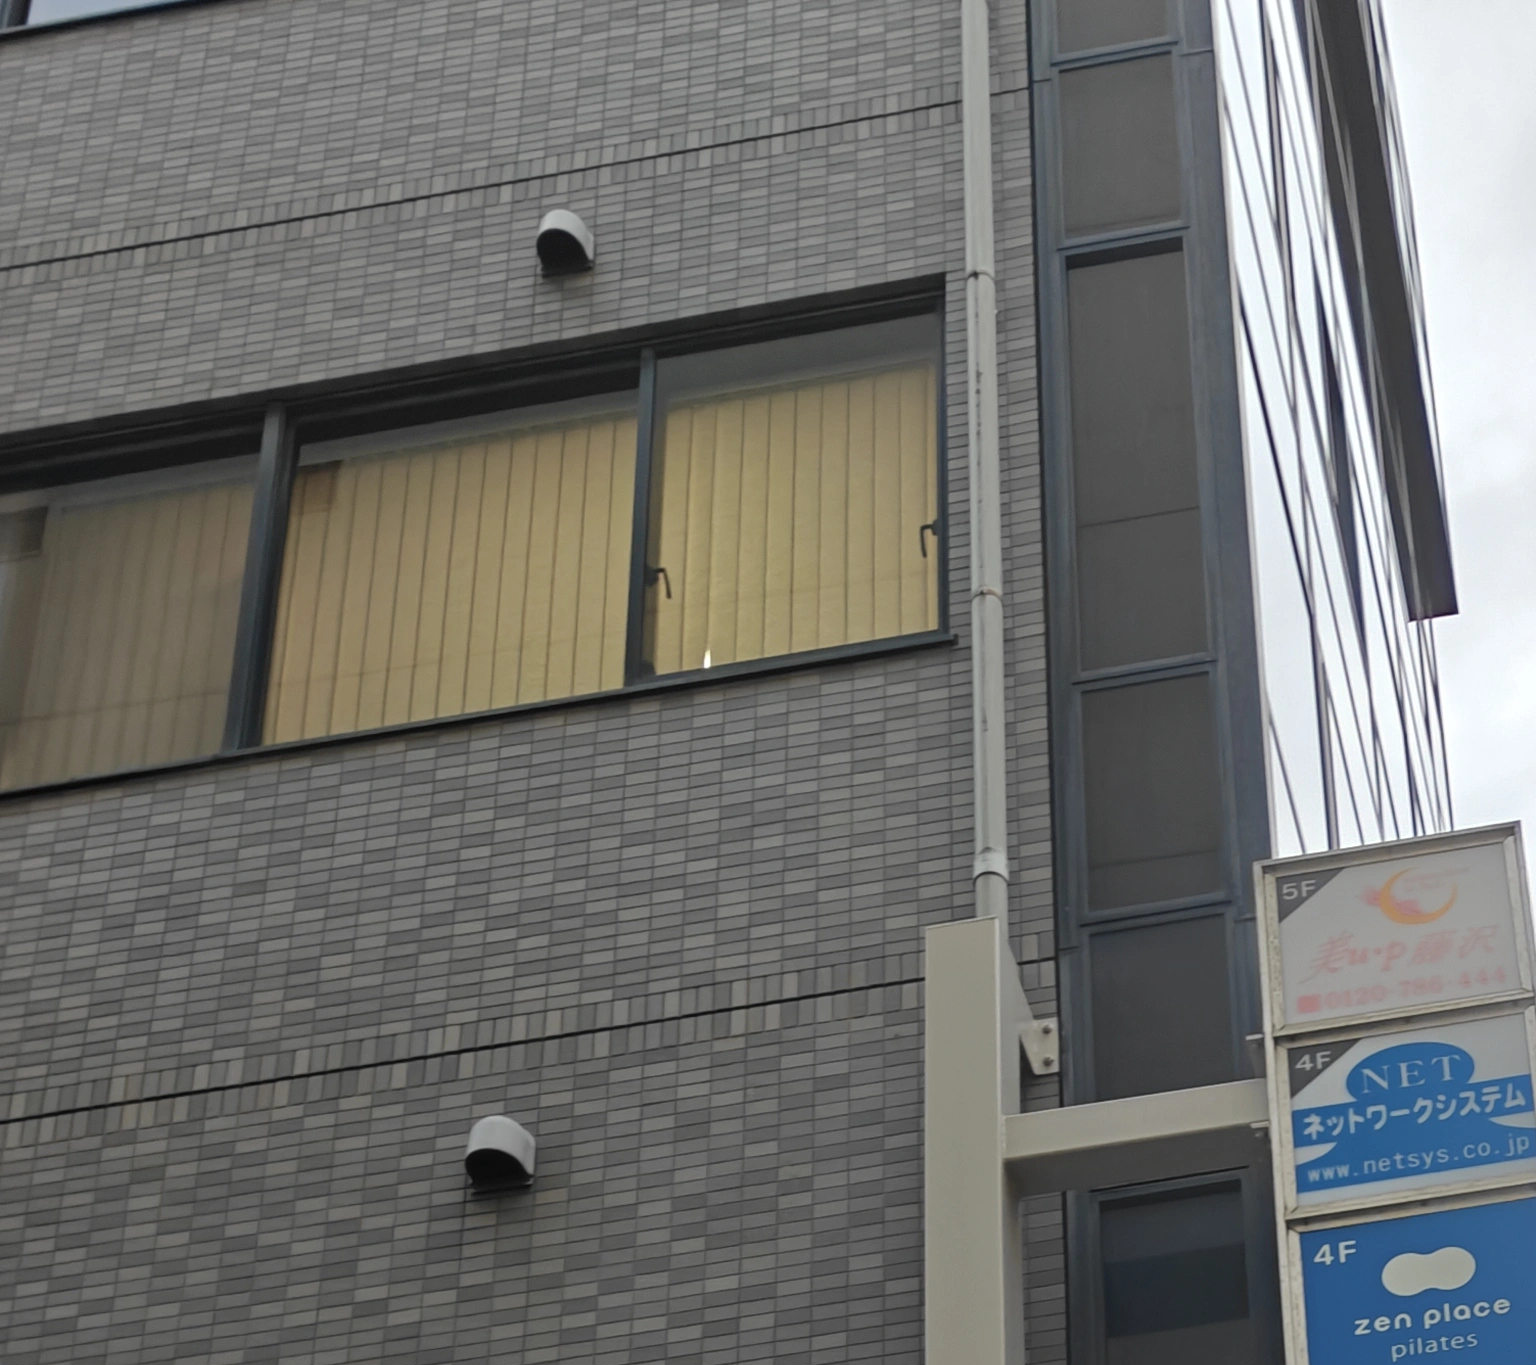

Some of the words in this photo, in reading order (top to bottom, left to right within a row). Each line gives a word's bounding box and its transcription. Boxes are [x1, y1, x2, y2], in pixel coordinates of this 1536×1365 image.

[1282, 879, 1317, 900] 5F
[1294, 1051, 1332, 1072] 4F
[1360, 1054, 1462, 1094] NET
[1303, 1083, 1527, 1140] ネットワークシステム
[1307, 1132, 1531, 1183] www.netsys.co.jp
[1313, 1240, 1359, 1267] 4F
[1354, 1308, 1413, 1336] zen
[1424, 1297, 1512, 1331] place
[1390, 1330, 1479, 1362] pilates
